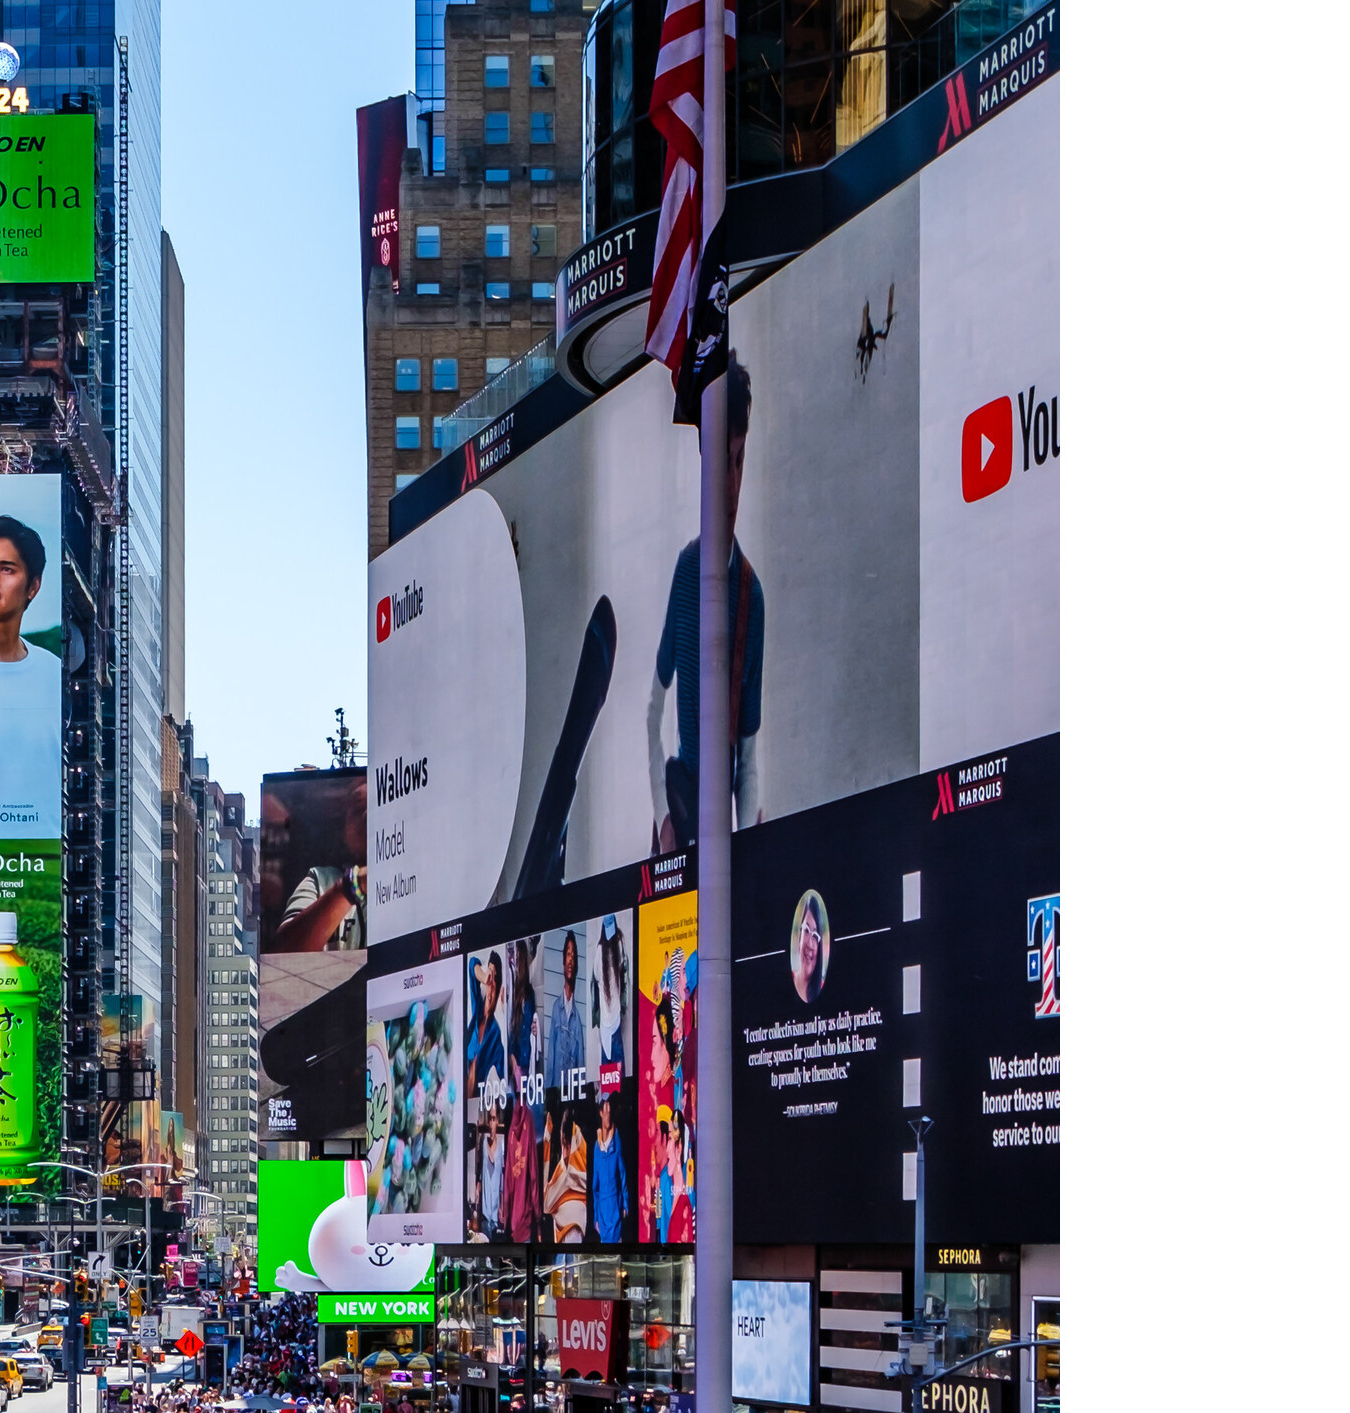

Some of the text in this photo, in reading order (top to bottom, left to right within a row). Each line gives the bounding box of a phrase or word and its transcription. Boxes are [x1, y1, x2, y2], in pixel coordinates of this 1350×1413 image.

[979, 8, 1055, 83] MARRIOTT
[979, 50, 1045, 116] MARQUIS
[15, 136, 46, 152] EN
[373, 208, 396, 224] ANNE
[371, 220, 399, 238] RICE'S
[3, 243, 28, 257] Tea
[567, 228, 636, 287] MARRIOTT
[567, 265, 625, 317] MARQUIS
[479, 412, 515, 450] MARRIOTT
[479, 438, 511, 472] MARQUIS
[392, 579, 423, 632] YouTube
[375, 756, 428, 807] Wallows
[958, 757, 1008, 785] MARRIOTT
[958, 781, 1001, 807] MARQUIS
[0, 811, 39, 822] Ohtani
[375, 820, 405, 864] Model
[654, 854, 686, 875] MARRIOTT
[2, 890, 16, 898] Tea
[375, 872, 417, 907] New Album
[654, 873, 682, 892] MARQUIS
[440, 923, 463, 939] MARRIOTT
[440, 938, 460, 953] MARQUIS
[5, 977, 18, 985] EN
[750, 1026, 768, 1042] center
[768, 1020, 804, 1040] collectivism
[804, 1016, 817, 1034] and
[817, 1016, 827, 1036] joy
[828, 1018, 836, 1030] as
[836, 1011, 853, 1032] daily
[748, 1034, 877, 1067] creating spaces for youth who look like me
[989, 1056, 1007, 1080] We
[1007, 1051, 1038, 1079] stand
[477, 1066, 586, 1112] TOPS FOR LIFE
[770, 1071, 778, 1087] to
[778, 1066, 802, 1090] proudly
[802, 1066, 811, 1083] be
[268, 1098, 292, 1108] Save
[269, 1107, 288, 1117] The
[982, 1090, 1013, 1114] honor
[1013, 1087, 1043, 1112] those
[268, 1116, 297, 1127] Music
[4, 1139, 17, 1147] Tea
[992, 1121, 1043, 1147] service to
[938, 1249, 981, 1265] SEPHORA
[335, 1301, 429, 1316] NEW YORK
[142, 1328, 157, 1337] 25
[737, 1316, 766, 1338] HEART
